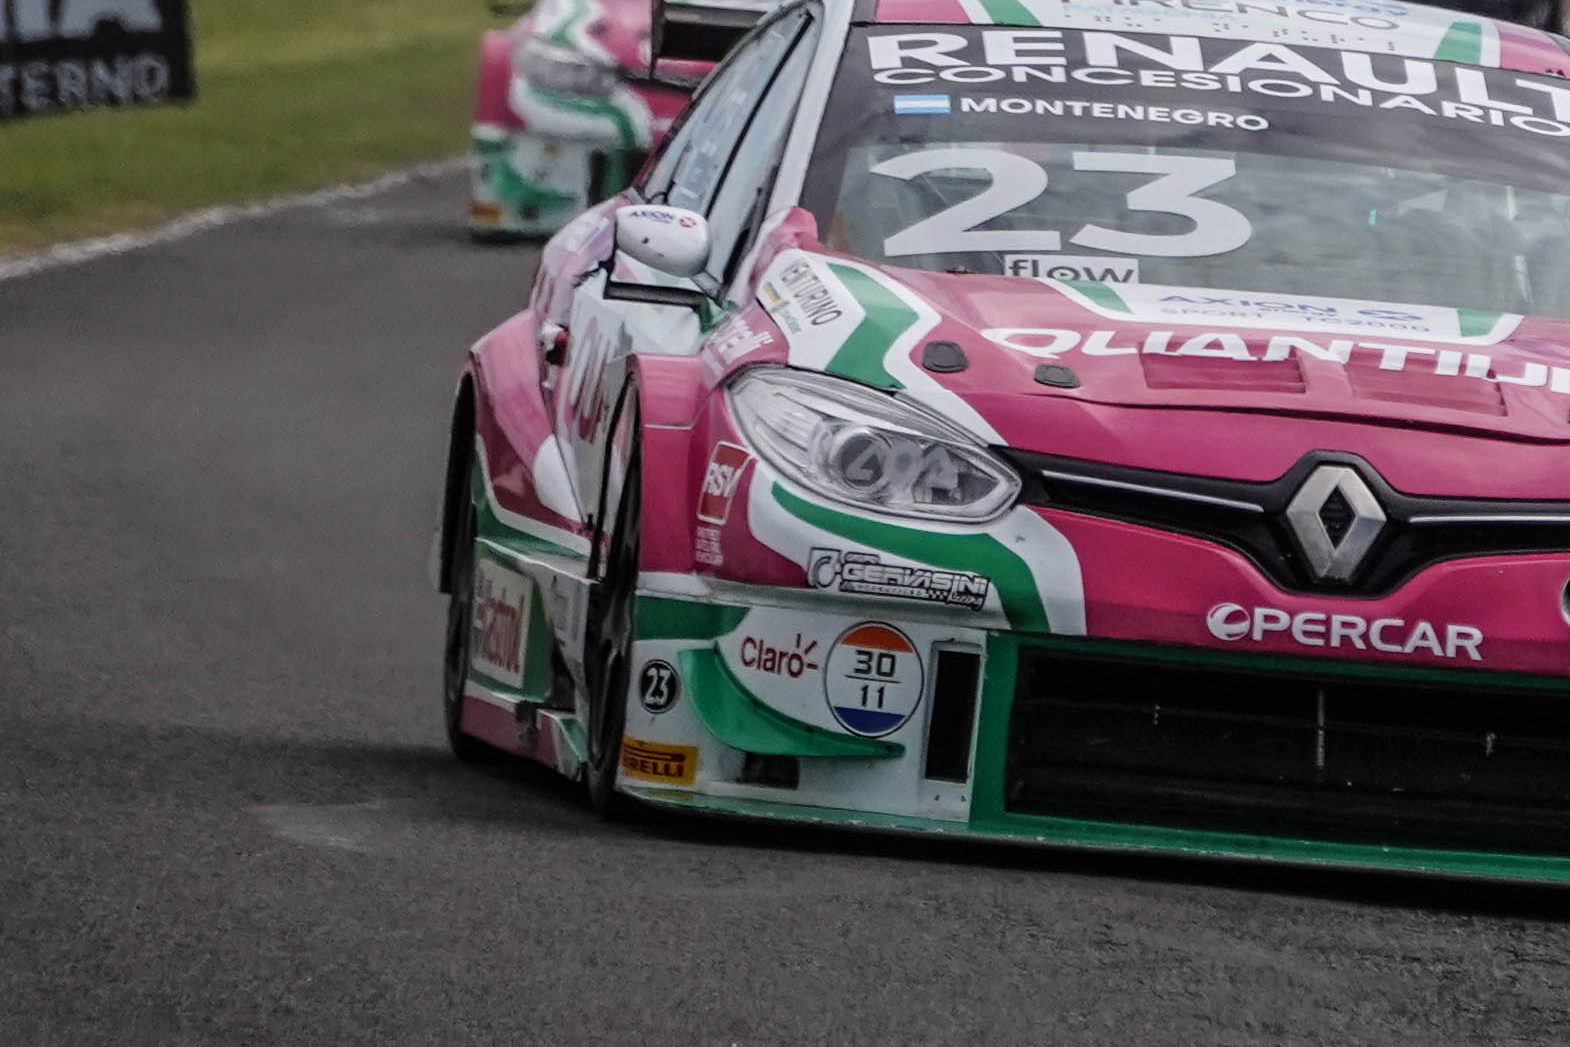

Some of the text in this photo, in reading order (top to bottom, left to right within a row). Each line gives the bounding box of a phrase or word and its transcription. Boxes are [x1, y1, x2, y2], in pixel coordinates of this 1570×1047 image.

[960, 97, 1269, 131] MONTENEGRO
[869, 149, 1253, 257] 23
[1008, 258, 1135, 283] flow
[741, 636, 804, 678] Claro
[853, 649, 897, 679] 30
[644, 665, 670, 705] 23
[860, 684, 886, 709] 11
